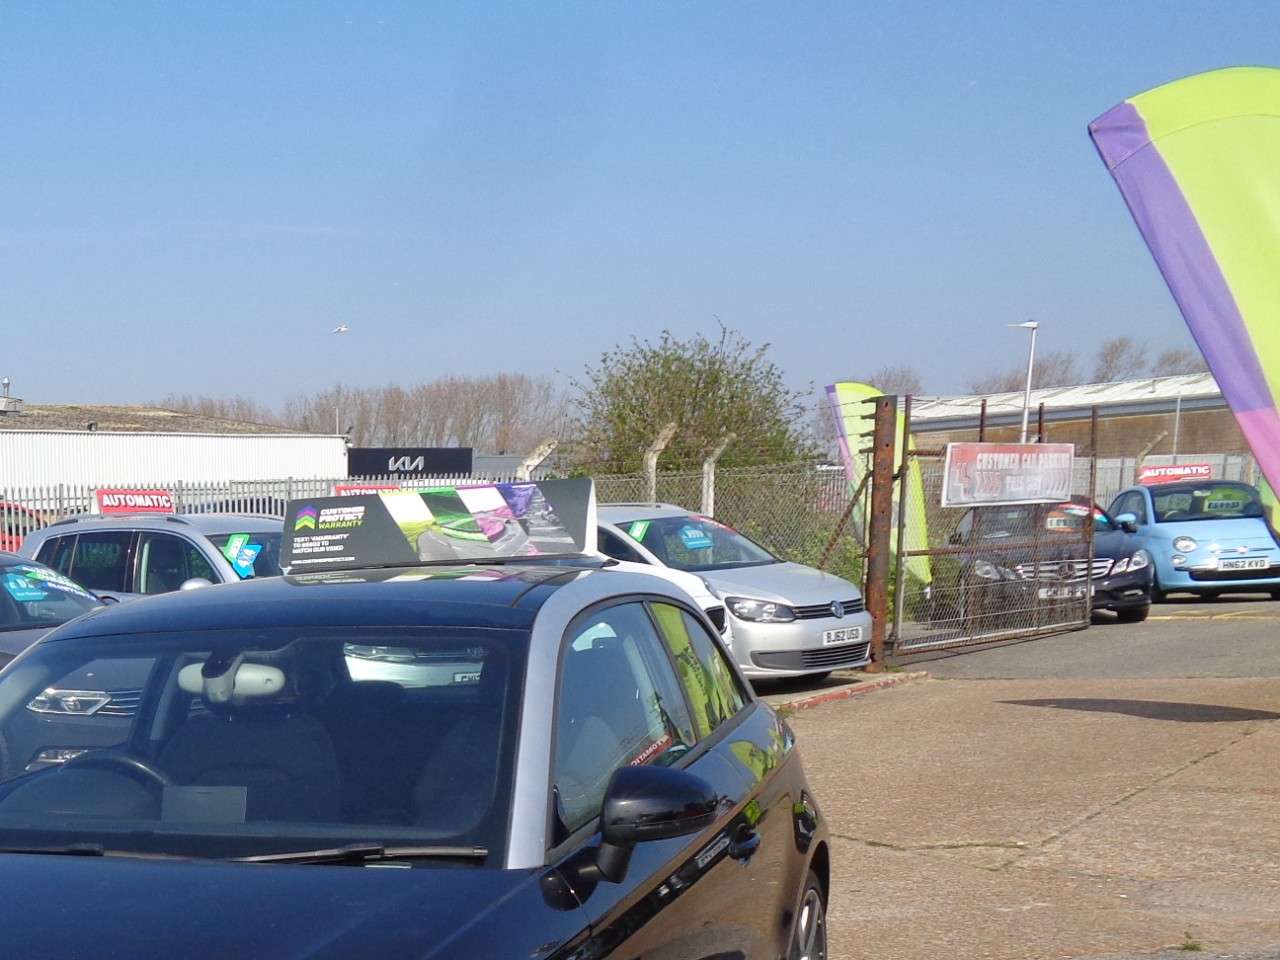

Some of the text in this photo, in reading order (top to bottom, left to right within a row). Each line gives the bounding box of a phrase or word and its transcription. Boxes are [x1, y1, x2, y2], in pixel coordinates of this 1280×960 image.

[1143, 466, 1209, 476] AUTOMATIC
[102, 494, 171, 507] AUTOMATIC
[319, 513, 364, 523] PROTECT
[319, 520, 363, 529] WARRANTY
